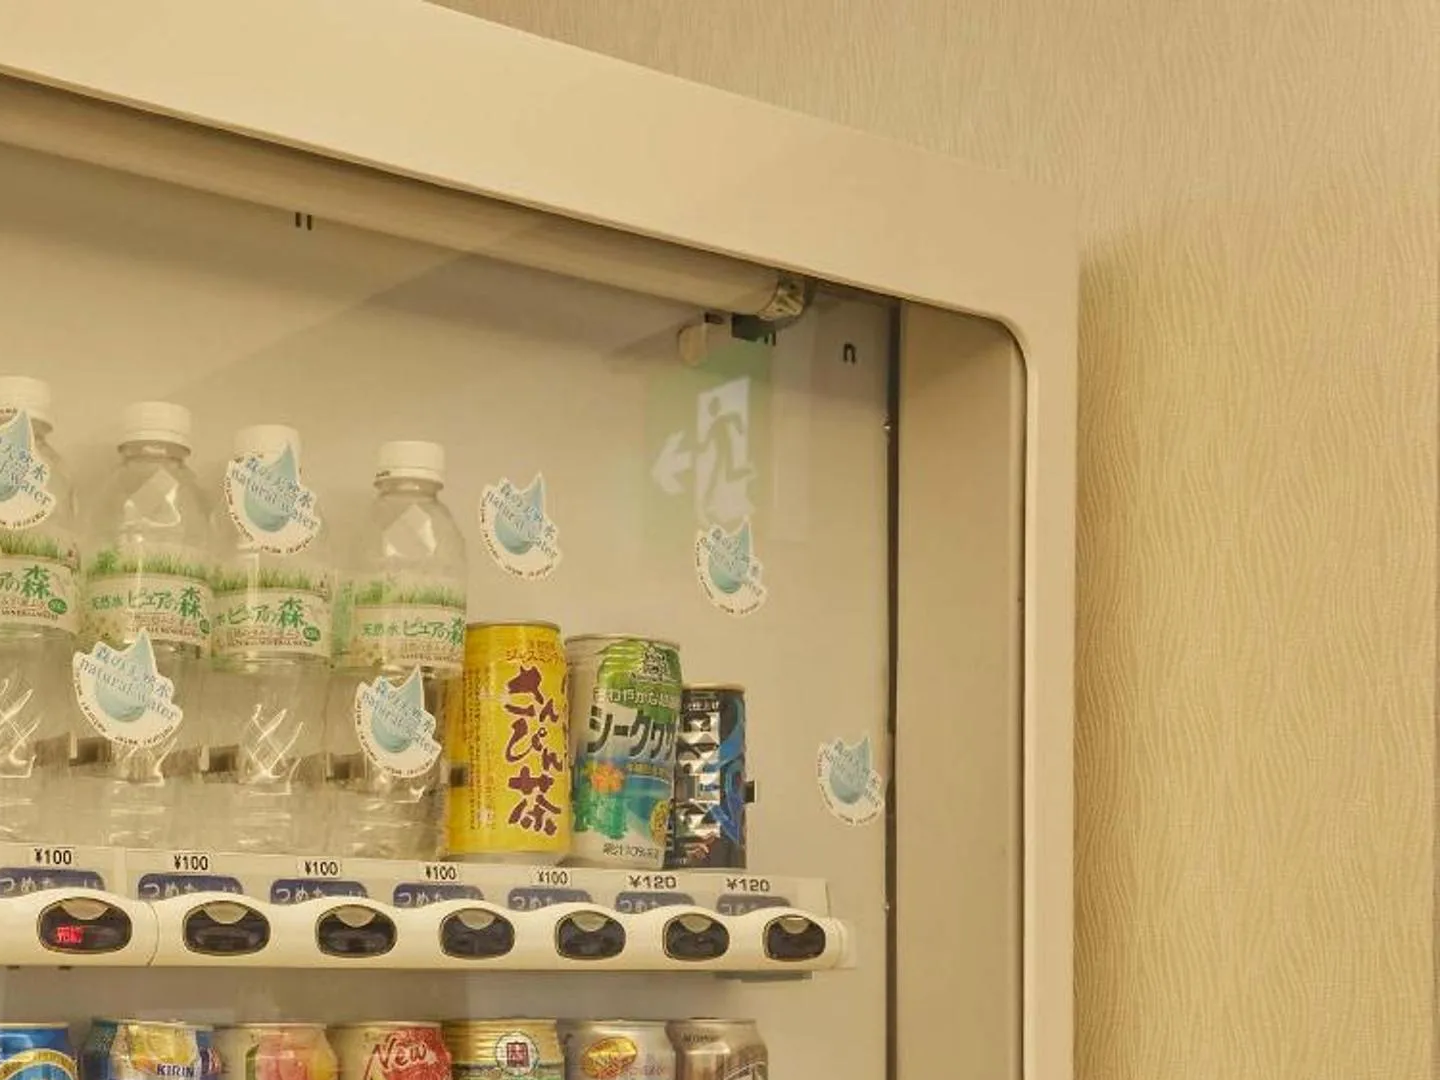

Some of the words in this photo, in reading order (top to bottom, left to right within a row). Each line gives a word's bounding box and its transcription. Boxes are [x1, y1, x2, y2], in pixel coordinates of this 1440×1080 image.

[504, 665, 564, 837] さんぴん茶
[33, 848, 73, 865] ¥100
[173, 855, 209, 871] ¥100
[304, 861, 339, 876] ¥100
[424, 866, 457, 880] ¥100
[537, 871, 569, 885] ¥100
[628, 875, 677, 889] ¥120
[726, 878, 771, 892] ¥120
[156, 1063, 195, 1079] KIRIN
